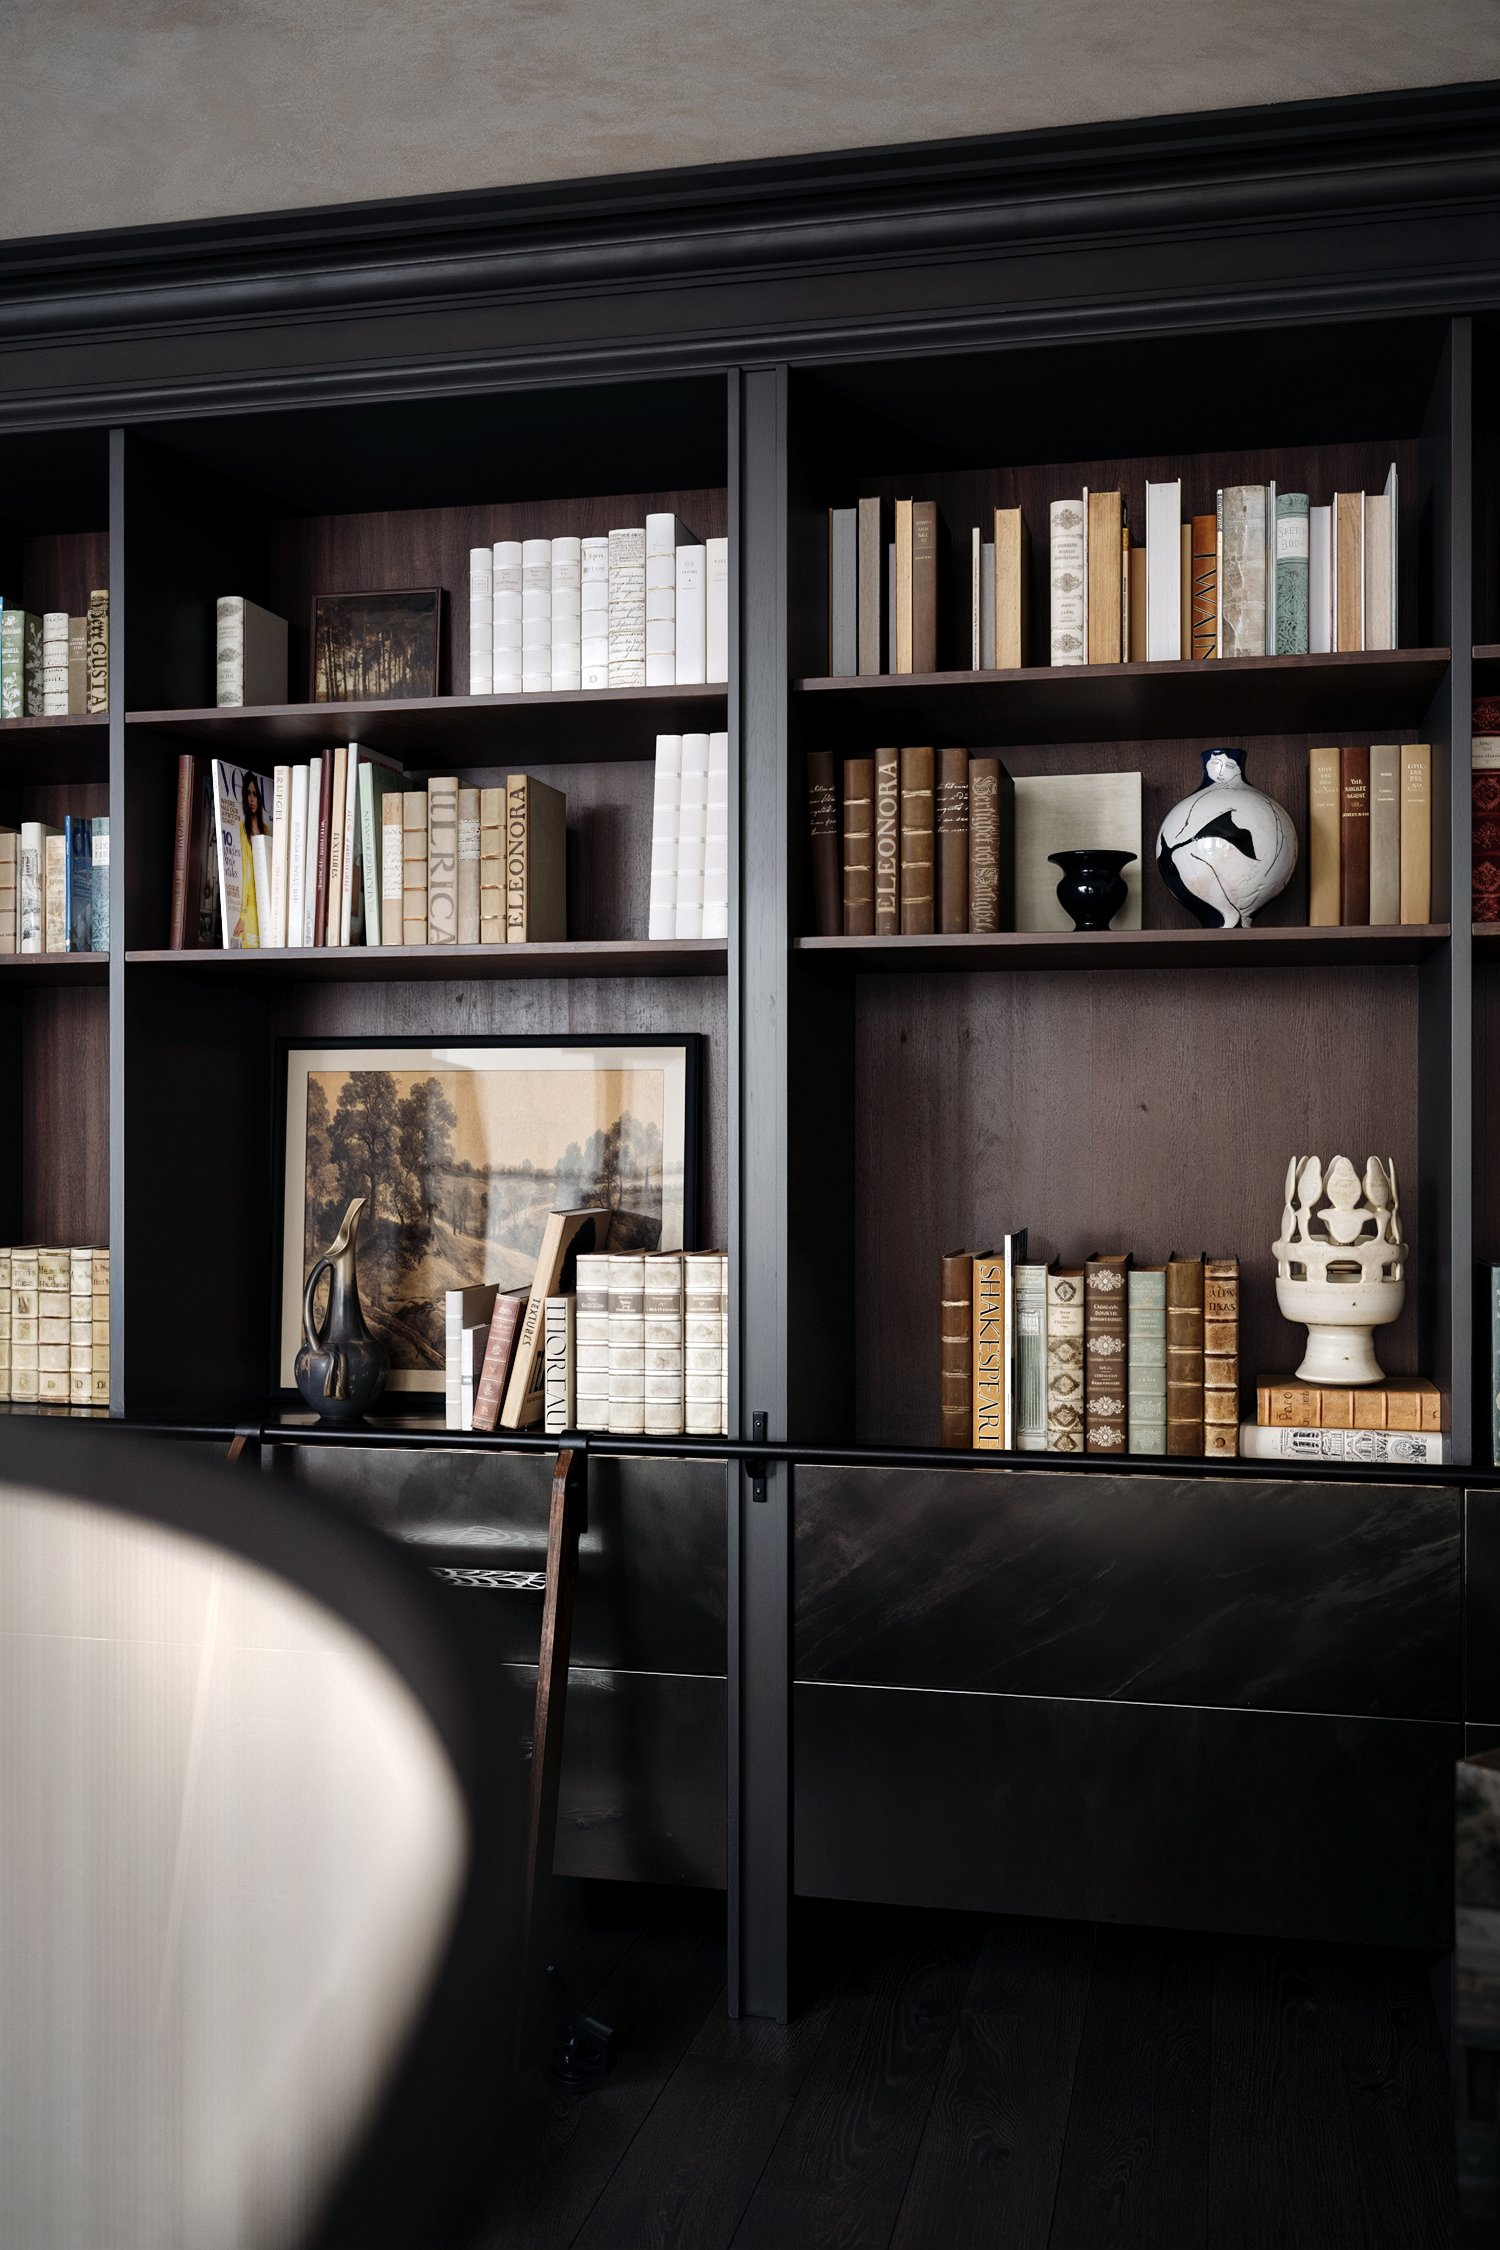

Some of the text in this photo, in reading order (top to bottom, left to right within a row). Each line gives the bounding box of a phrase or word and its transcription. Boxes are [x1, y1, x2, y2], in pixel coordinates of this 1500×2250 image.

[1193, 549, 1217, 659] TWAIN
[91, 641, 108, 713] GUSTA
[222, 830, 233, 846] 10
[429, 789, 456, 944] ULRICA
[507, 786, 526, 929] ELEONORA
[877, 760, 898, 914] ELEONORA
[522, 1297, 542, 1347] TEXTURES
[545, 1306, 568, 1428] THOREAU
[978, 1265, 1002, 1449] SHAKESPEARE
